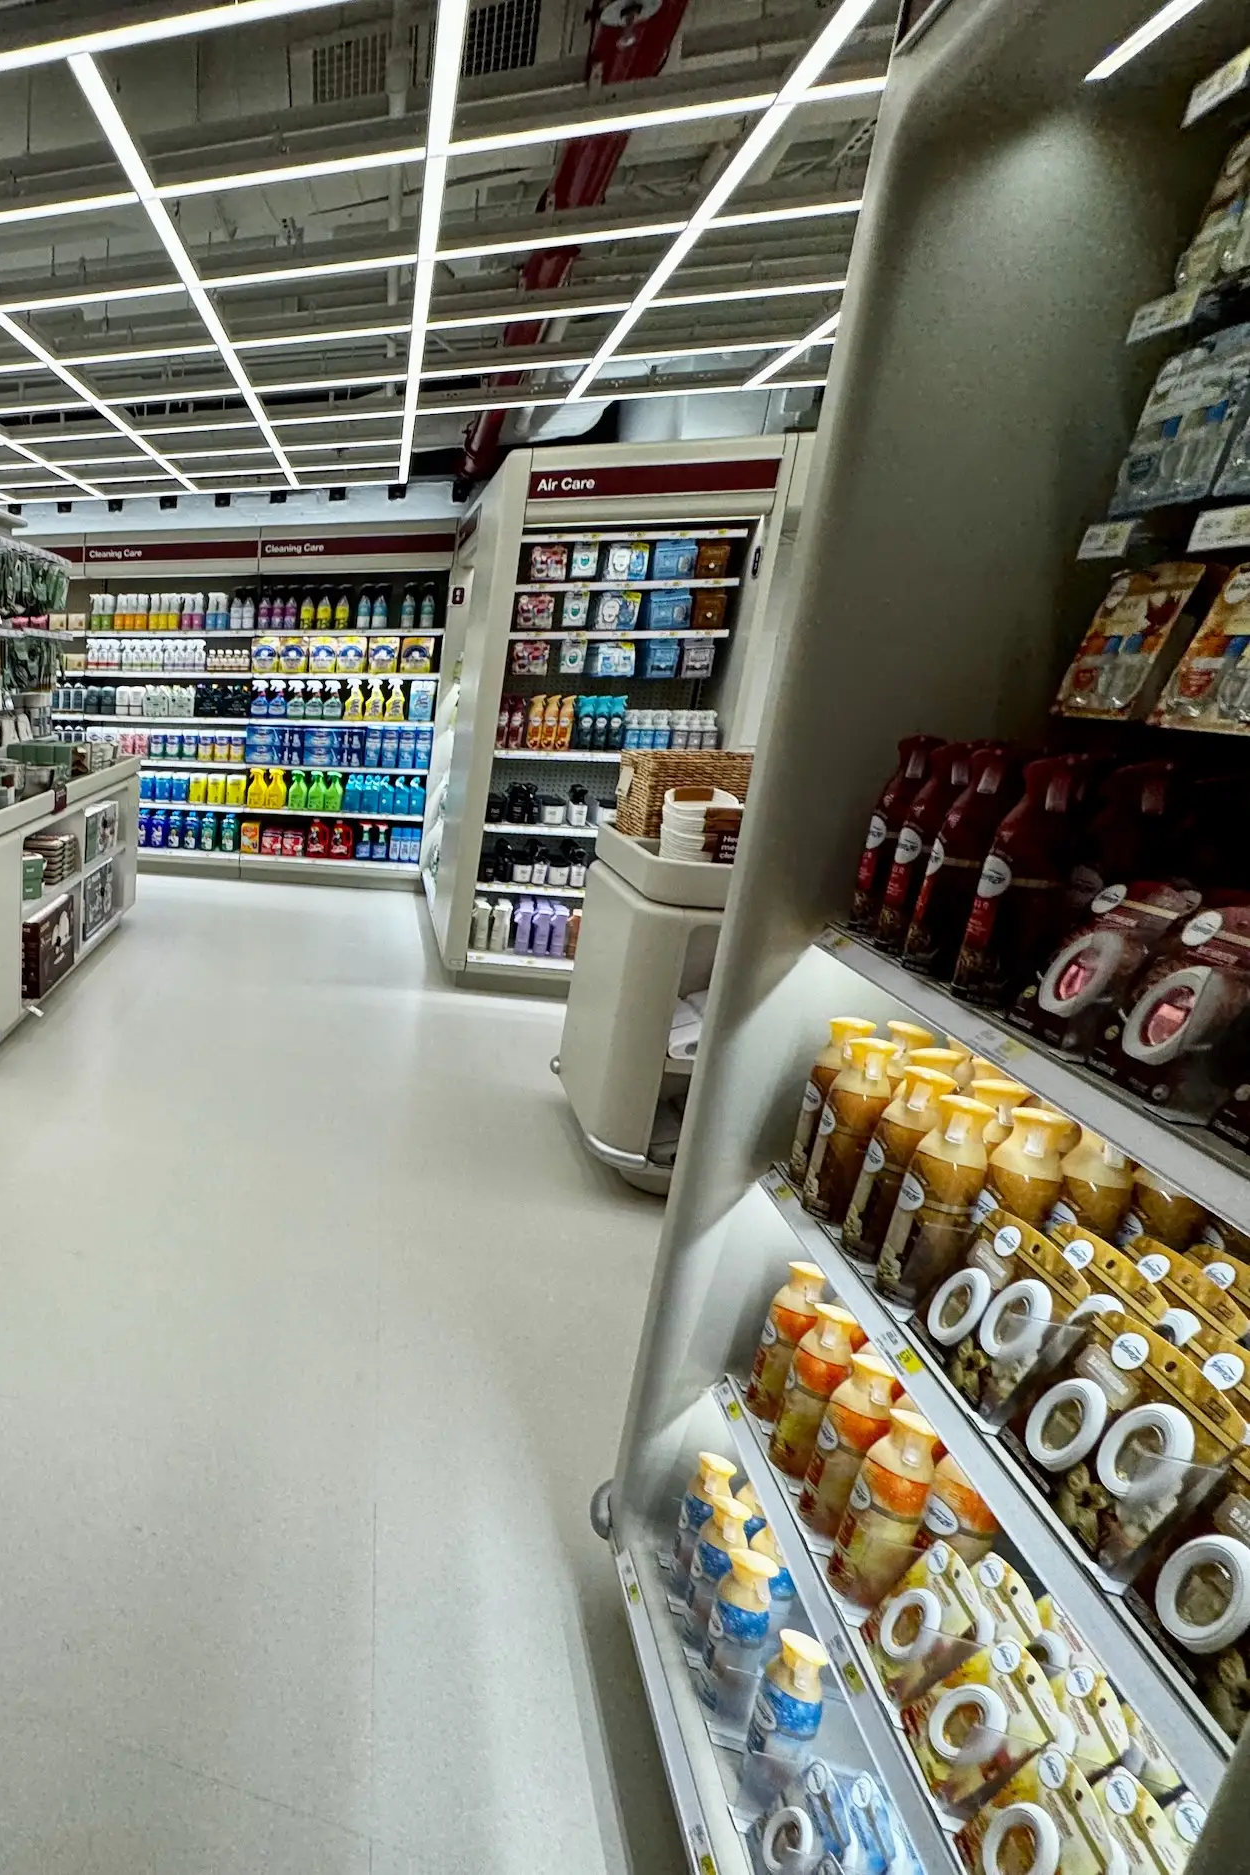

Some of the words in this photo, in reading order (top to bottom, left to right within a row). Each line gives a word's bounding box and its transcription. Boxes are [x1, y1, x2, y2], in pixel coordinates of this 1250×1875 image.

[537, 478, 558, 492] Air
[561, 477, 596, 491] Care
[89, 549, 122, 559] Cleaning
[123, 548, 143, 558] Care
[265, 544, 302, 554] Cleaning
[303, 543, 325, 552] Care
